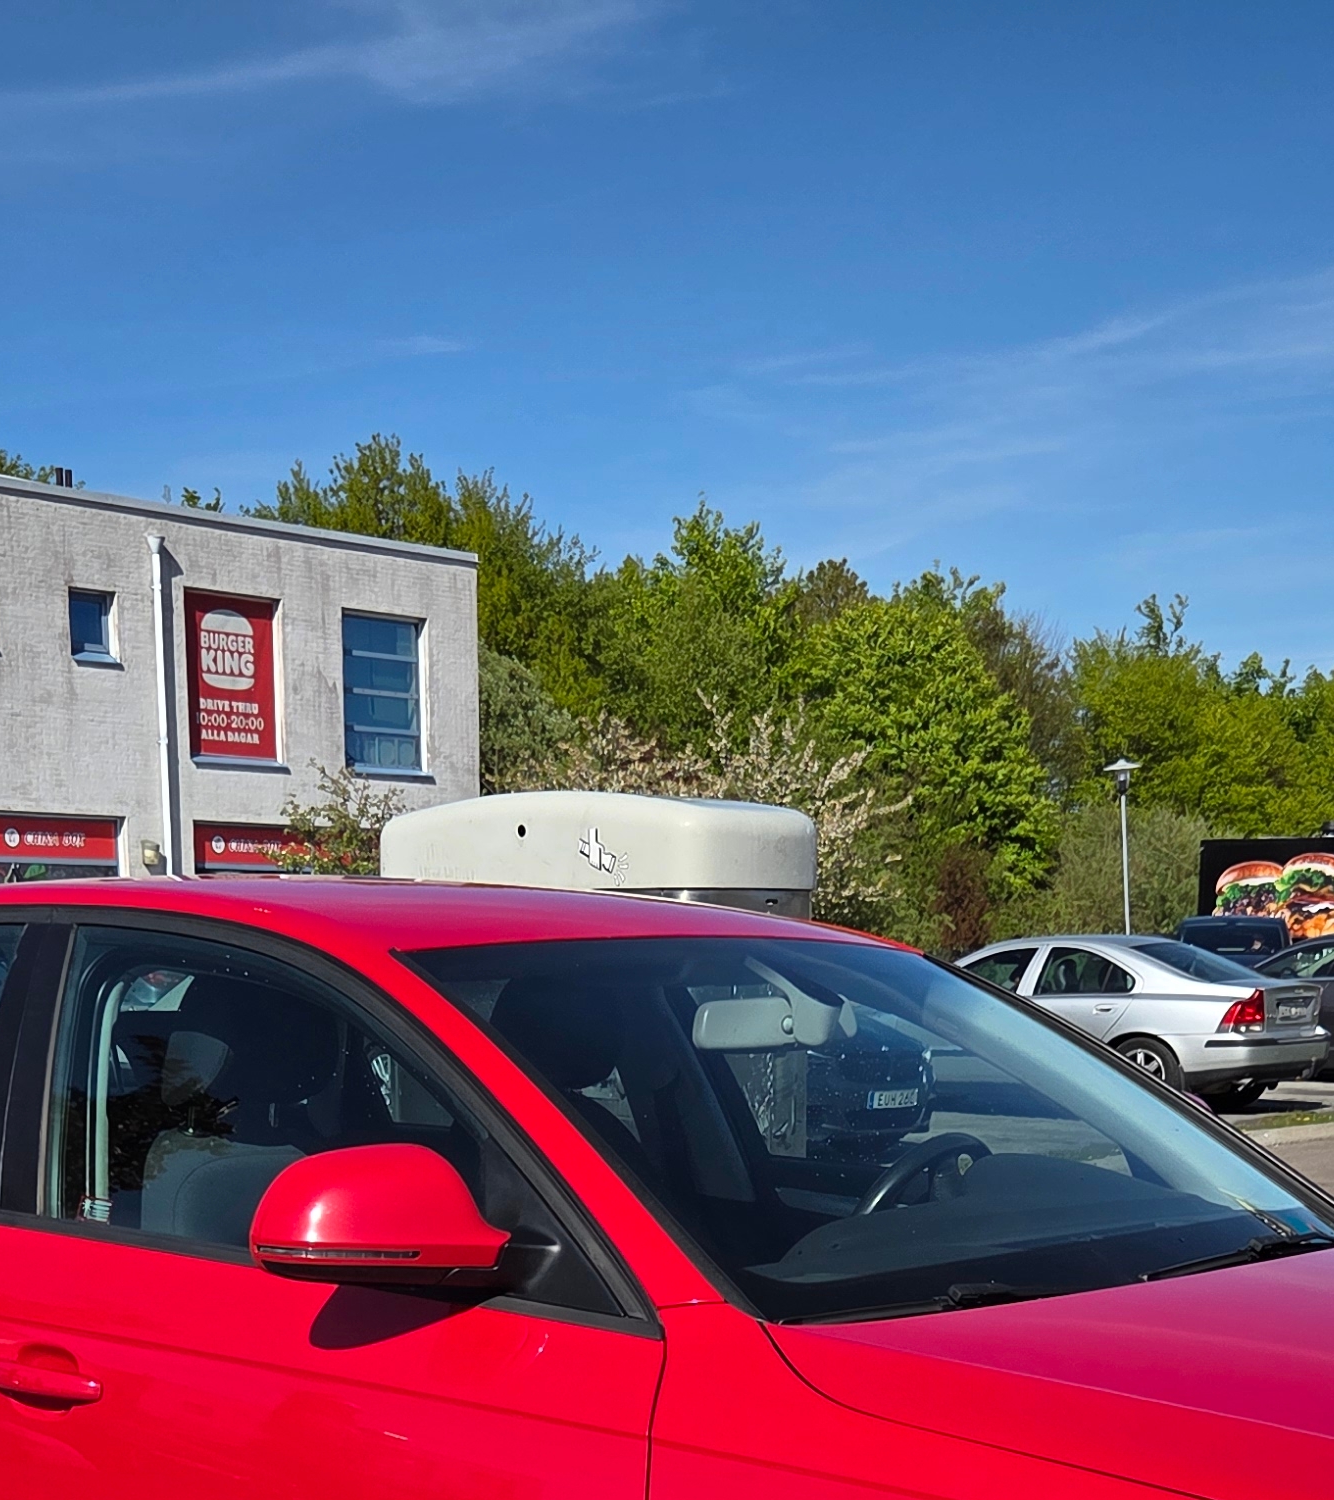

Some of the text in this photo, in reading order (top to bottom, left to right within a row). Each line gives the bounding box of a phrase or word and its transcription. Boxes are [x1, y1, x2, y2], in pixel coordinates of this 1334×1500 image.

[200, 631, 254, 654] BURGER
[200, 648, 255, 676] KING
[199, 697, 259, 714] DRIVE THRU
[201, 728, 260, 744] ALLA DAGAR
